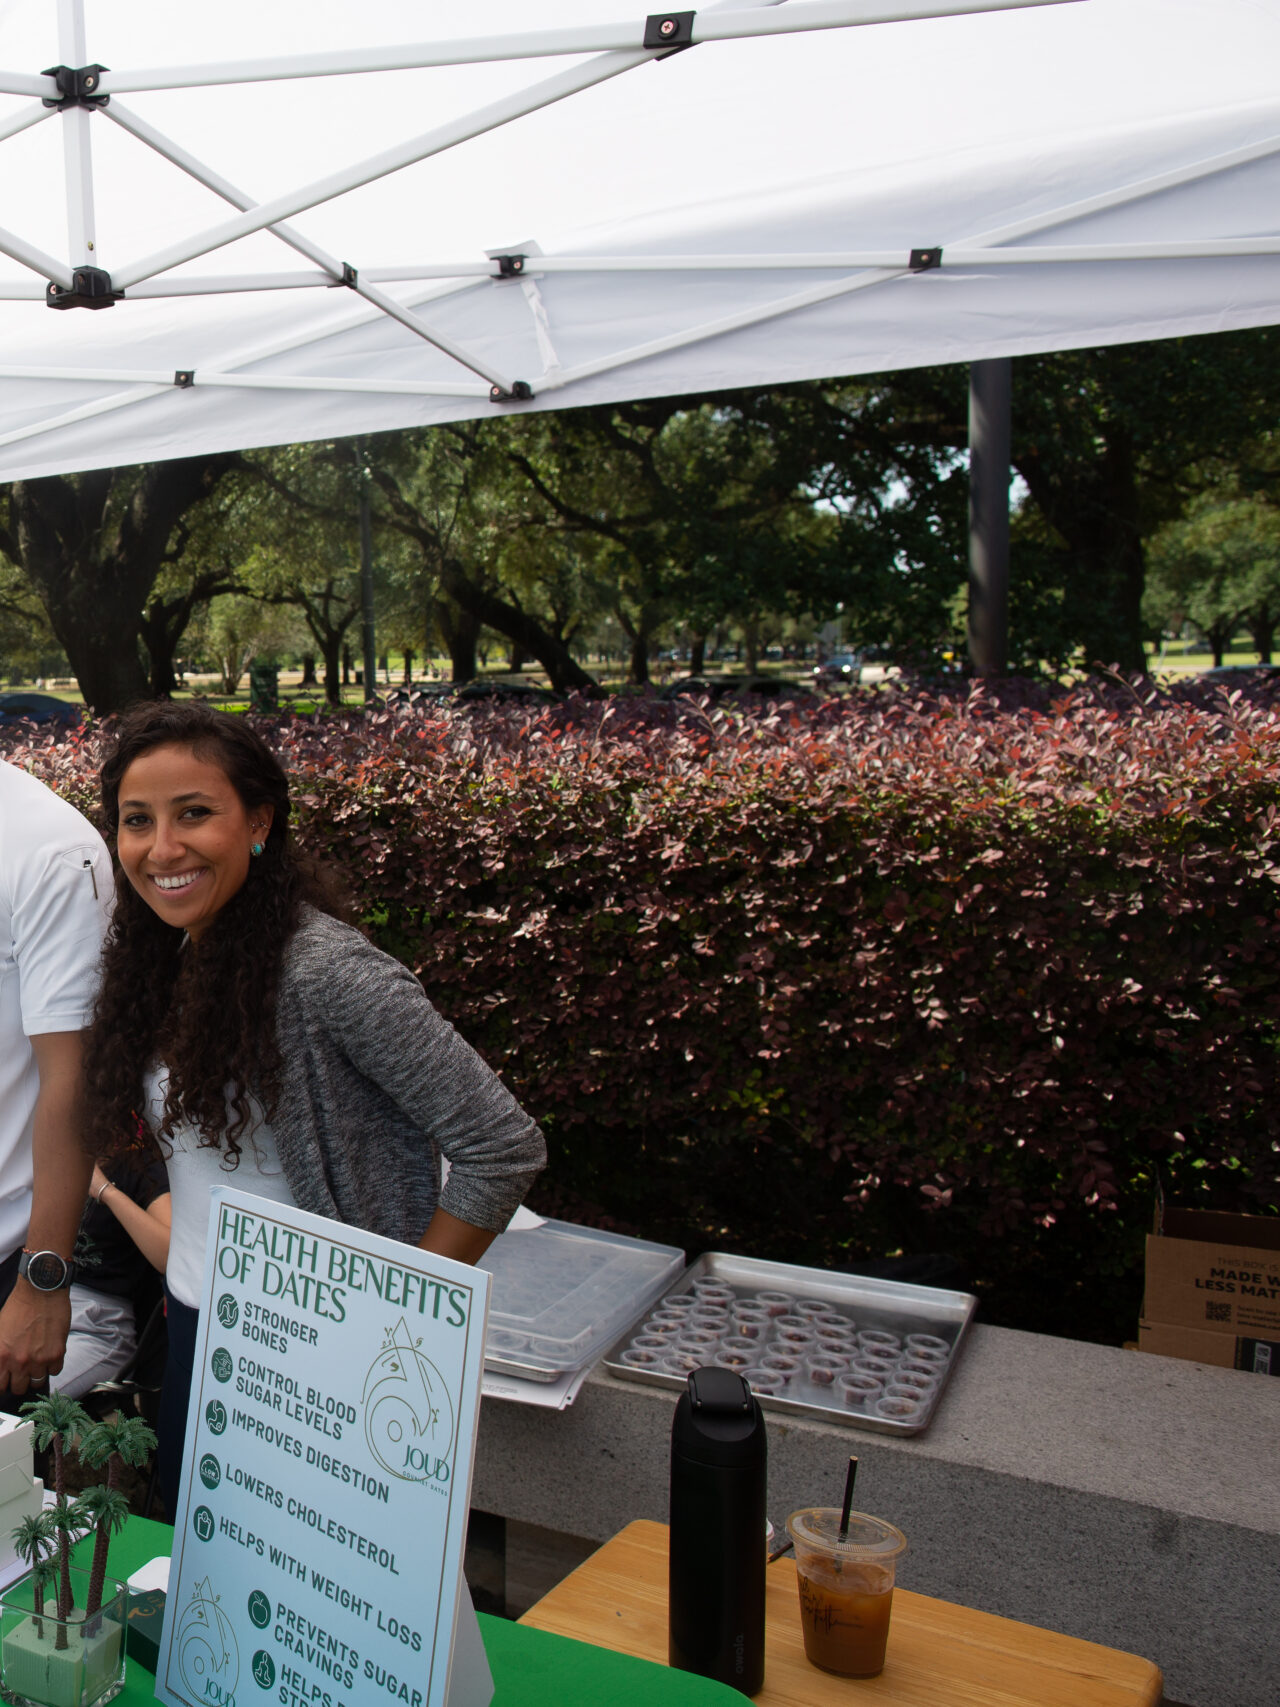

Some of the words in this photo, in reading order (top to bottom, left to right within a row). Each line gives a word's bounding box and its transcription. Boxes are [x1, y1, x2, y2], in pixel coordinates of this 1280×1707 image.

[218, 1246, 255, 1285] OF
[262, 1261, 347, 1324] DATES
[221, 1209, 319, 1274] HEALTH
[327, 1245, 467, 1328] BENEFITS
[1195, 1278, 1236, 1293] LESS
[1210, 1267, 1262, 1284] MADE
[242, 1321, 288, 1354] BONES
[244, 1301, 319, 1347] STRONGER
[236, 1377, 281, 1416] SUGAR
[285, 1401, 343, 1441] LEVELS
[238, 1357, 304, 1399] CONTROL
[306, 1388, 357, 1425] BLOOD
[232, 1409, 302, 1458] IMPROVES
[306, 1446, 390, 1504] DIGESTION
[402, 1444, 450, 1482] JOUD
[225, 1463, 283, 1509] LOWERS
[287, 1498, 400, 1576] CHOLESTEROL
[220, 1516, 264, 1556] HELPS
[269, 1545, 306, 1582] WITH
[311, 1569, 373, 1622] WEIGHT
[377, 1610, 422, 1652] LOSS
[274, 1624, 354, 1690] CRAVINGS
[276, 1602, 359, 1670] PREVENTS
[363, 1659, 423, 1707] SUGAR
[280, 1663, 333, 1707] HELPS
[204, 1677, 236, 1707] JOUD
